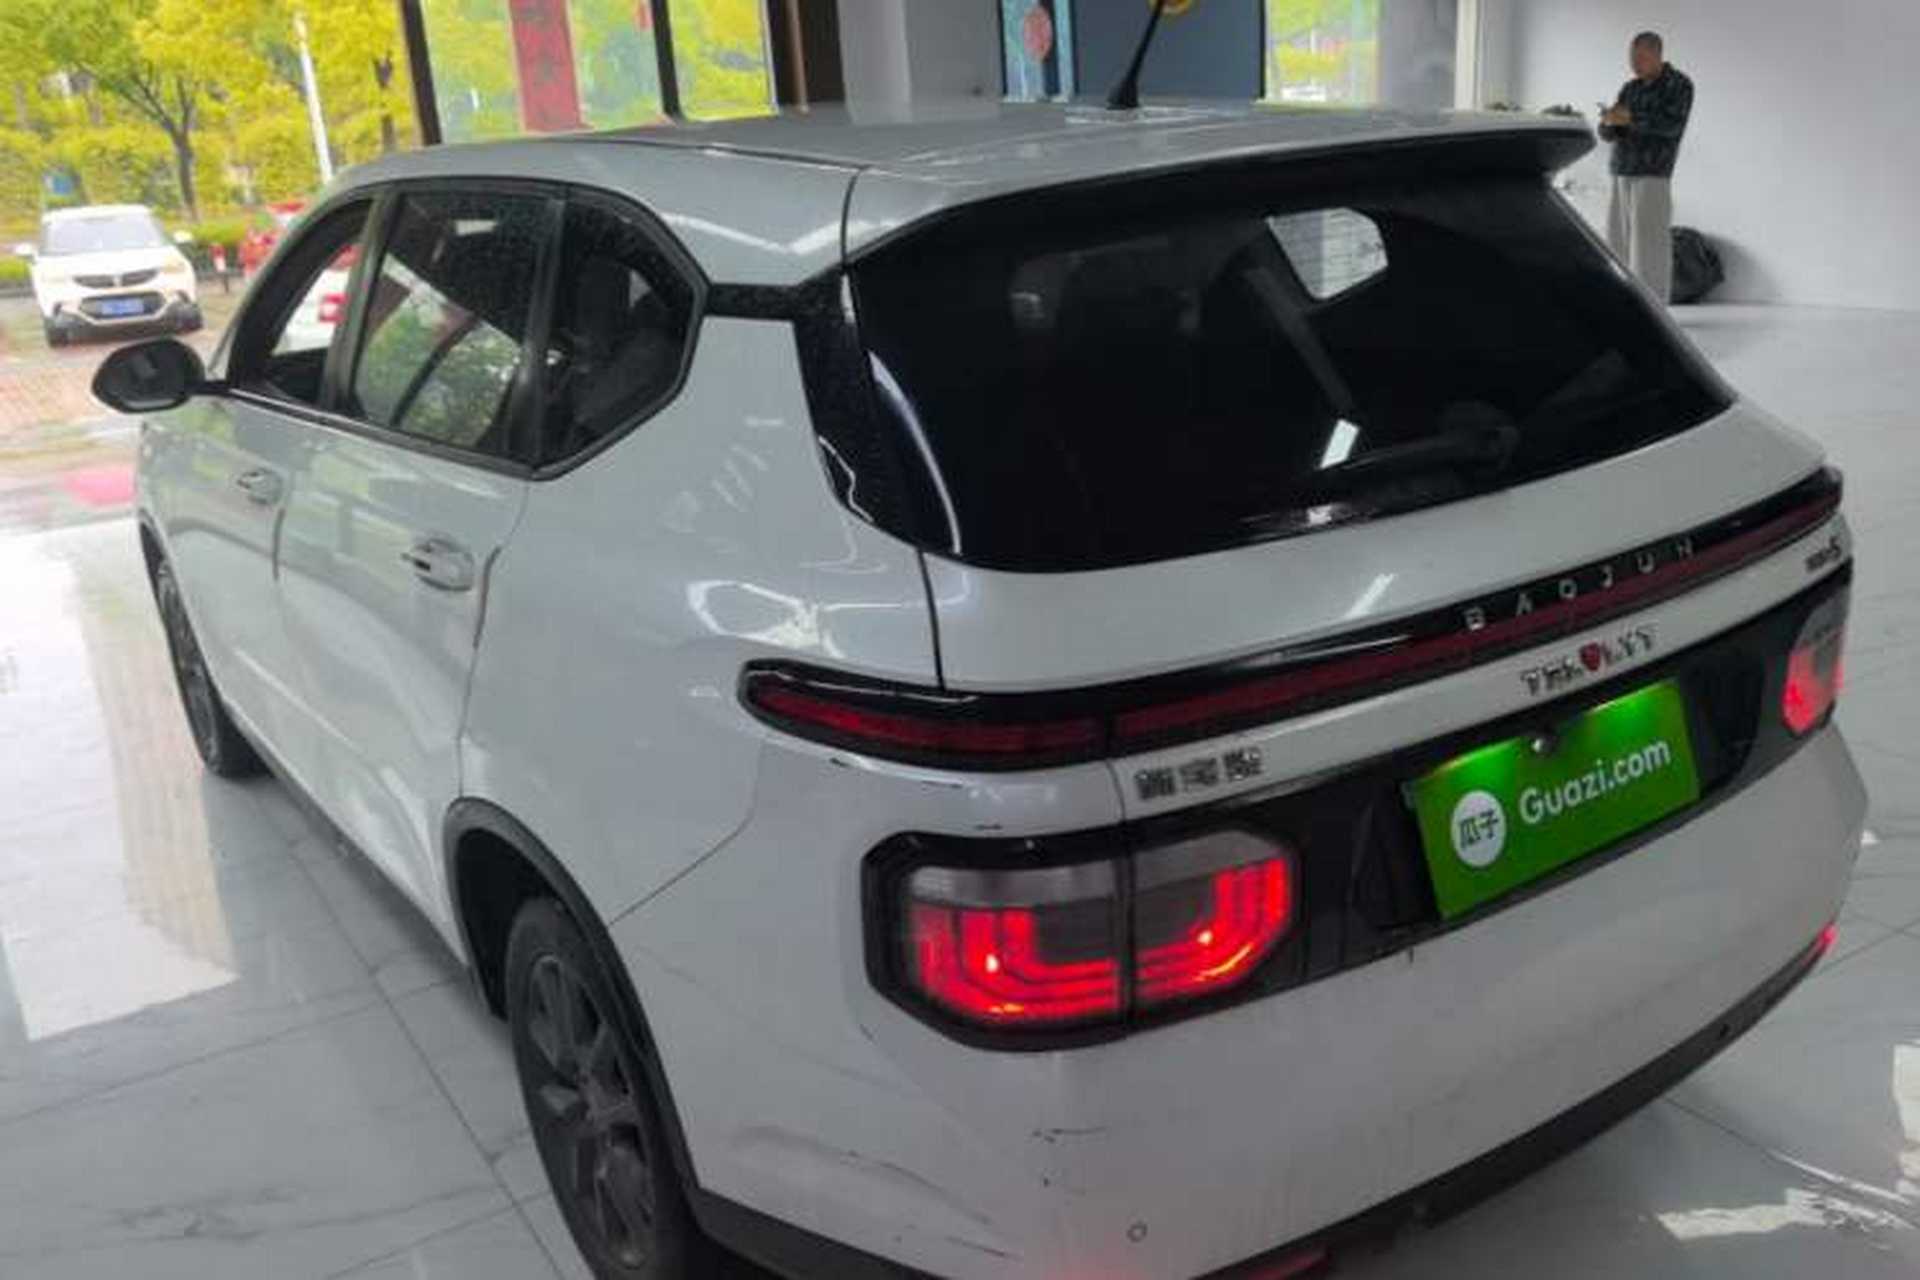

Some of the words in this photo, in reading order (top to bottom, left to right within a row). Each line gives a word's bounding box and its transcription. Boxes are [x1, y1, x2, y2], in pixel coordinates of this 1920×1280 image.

[1465, 538, 1692, 631] BAOJUN
[1519, 740, 1672, 825] Guazi.com
[1459, 808, 1498, 849] 瓜子
